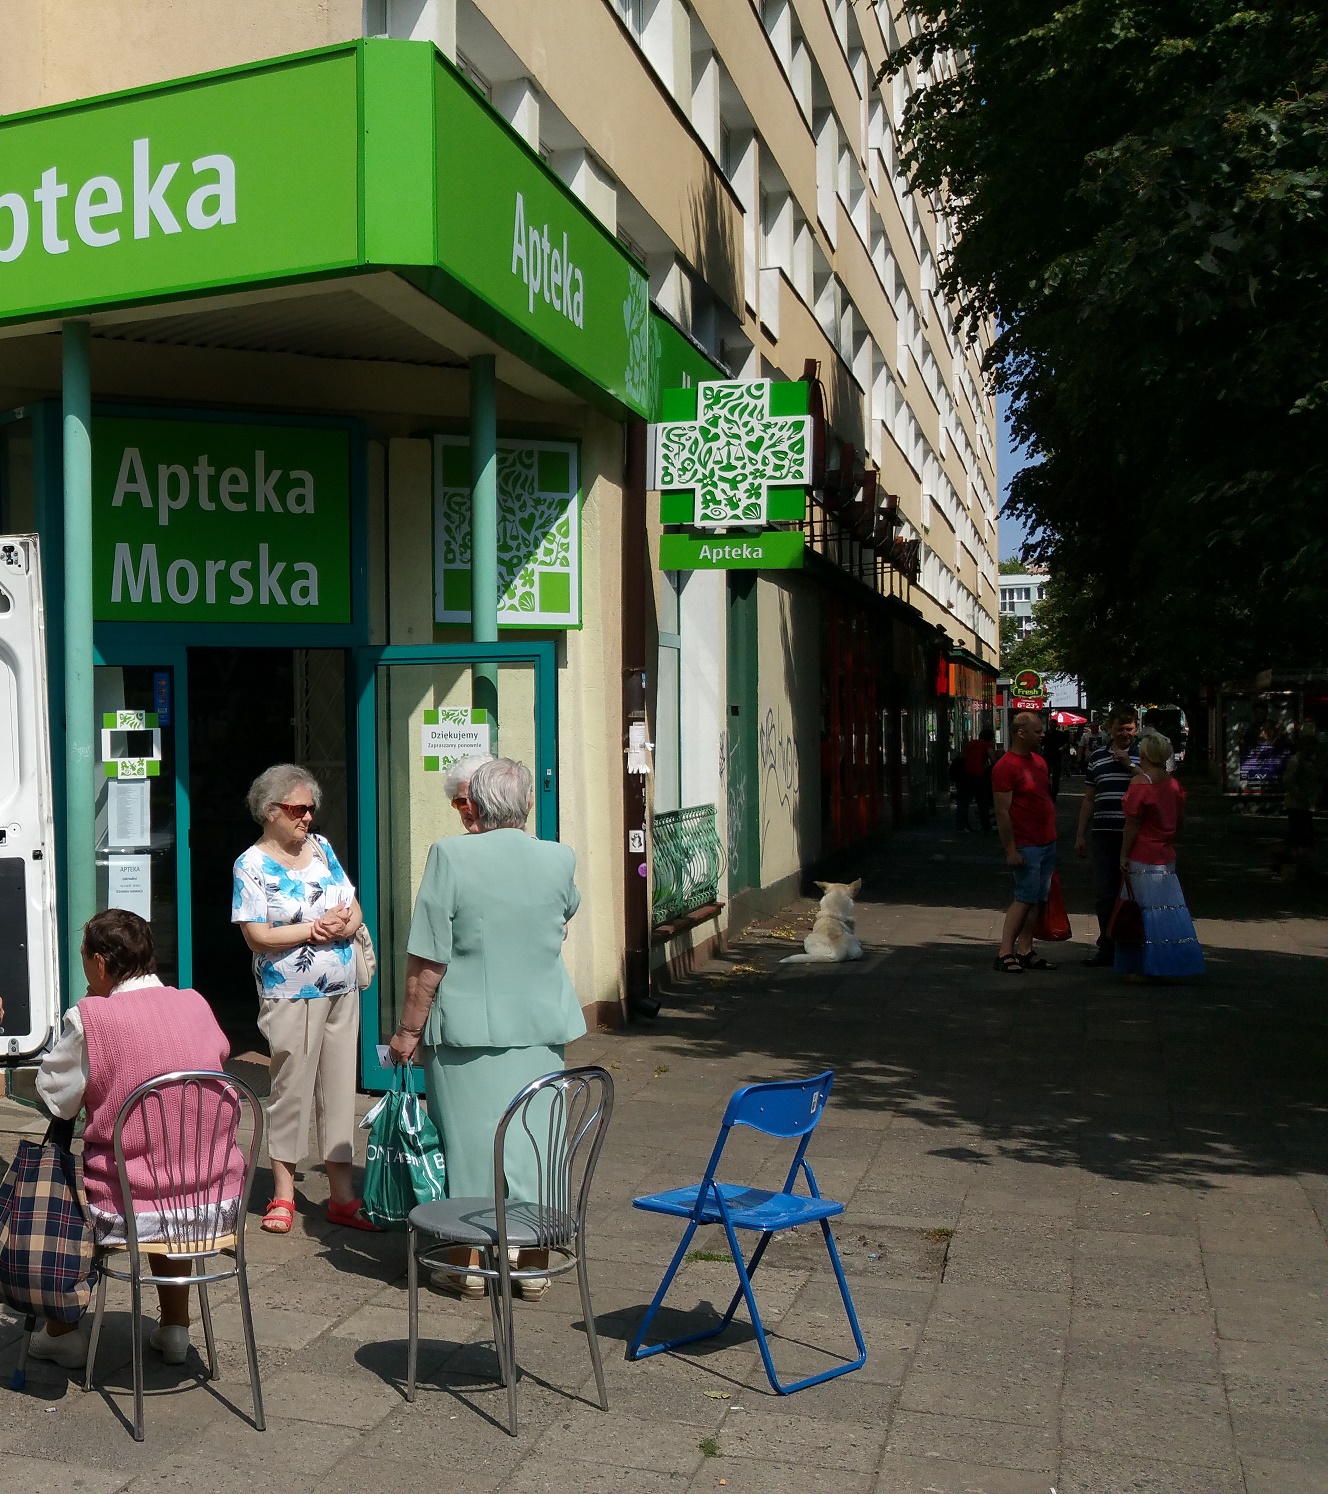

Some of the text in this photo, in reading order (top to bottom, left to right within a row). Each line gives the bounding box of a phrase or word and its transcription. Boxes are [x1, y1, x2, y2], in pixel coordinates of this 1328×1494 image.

[510, 190, 585, 331] Apteka
[111, 446, 316, 526] Apteka
[110, 542, 320, 607] Morska
[698, 543, 763, 563] Apteka
[431, 731, 479, 740] Dziękujemy
